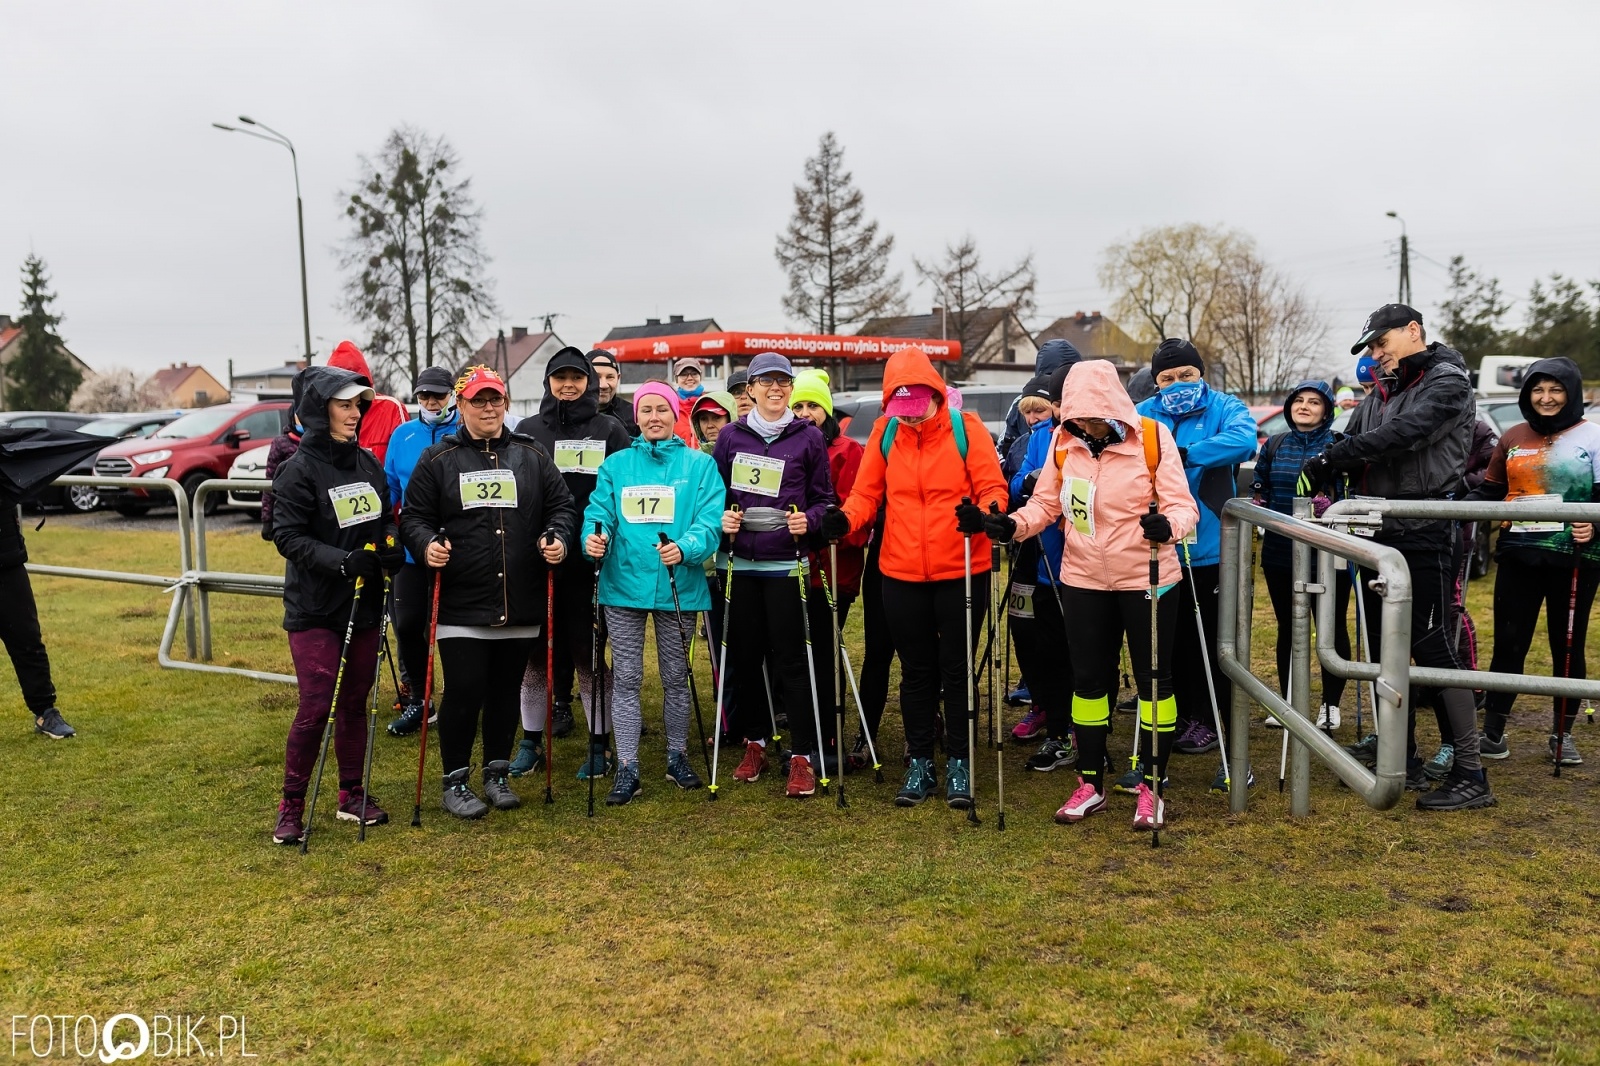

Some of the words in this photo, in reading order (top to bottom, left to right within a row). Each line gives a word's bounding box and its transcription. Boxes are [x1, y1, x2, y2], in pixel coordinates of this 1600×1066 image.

[652, 342, 670, 355] 24h
[843, 339, 880, 354] myjnia
[881, 341, 950, 356] bezdkowa
[575, 450, 583, 466] 1
[749, 467, 761, 485] 3
[476, 482, 503, 500] 32
[348, 495, 372, 516] 23
[637, 497, 661, 515] 17
[1071, 493, 1088, 521] 37
[1010, 593, 1026, 610] 20
[344, 620, 355, 645] LEKI
